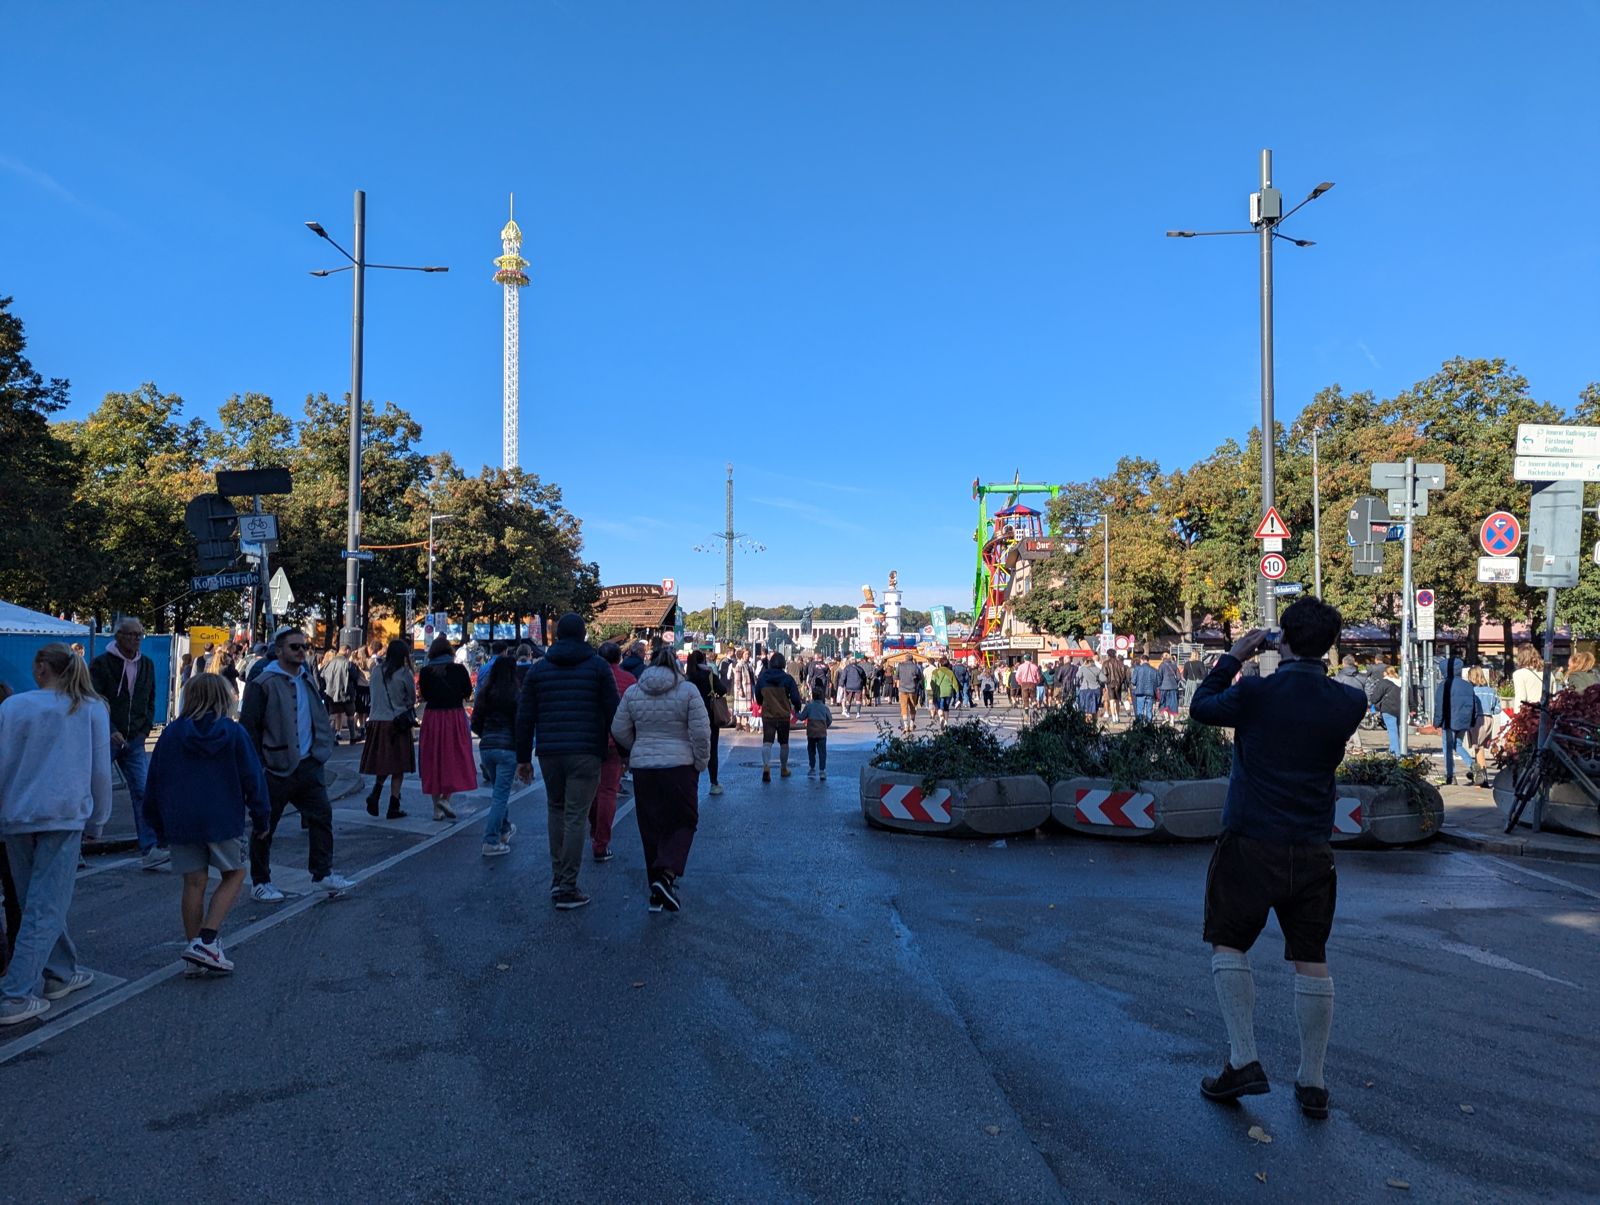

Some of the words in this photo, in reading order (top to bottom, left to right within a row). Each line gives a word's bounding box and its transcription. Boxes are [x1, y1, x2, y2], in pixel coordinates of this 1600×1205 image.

[1267, 560, 1280, 572] 10
[194, 573, 259, 590] Kollstraße
[602, 586, 649, 598] DSTUBEN
[200, 632, 220, 640] Cash
